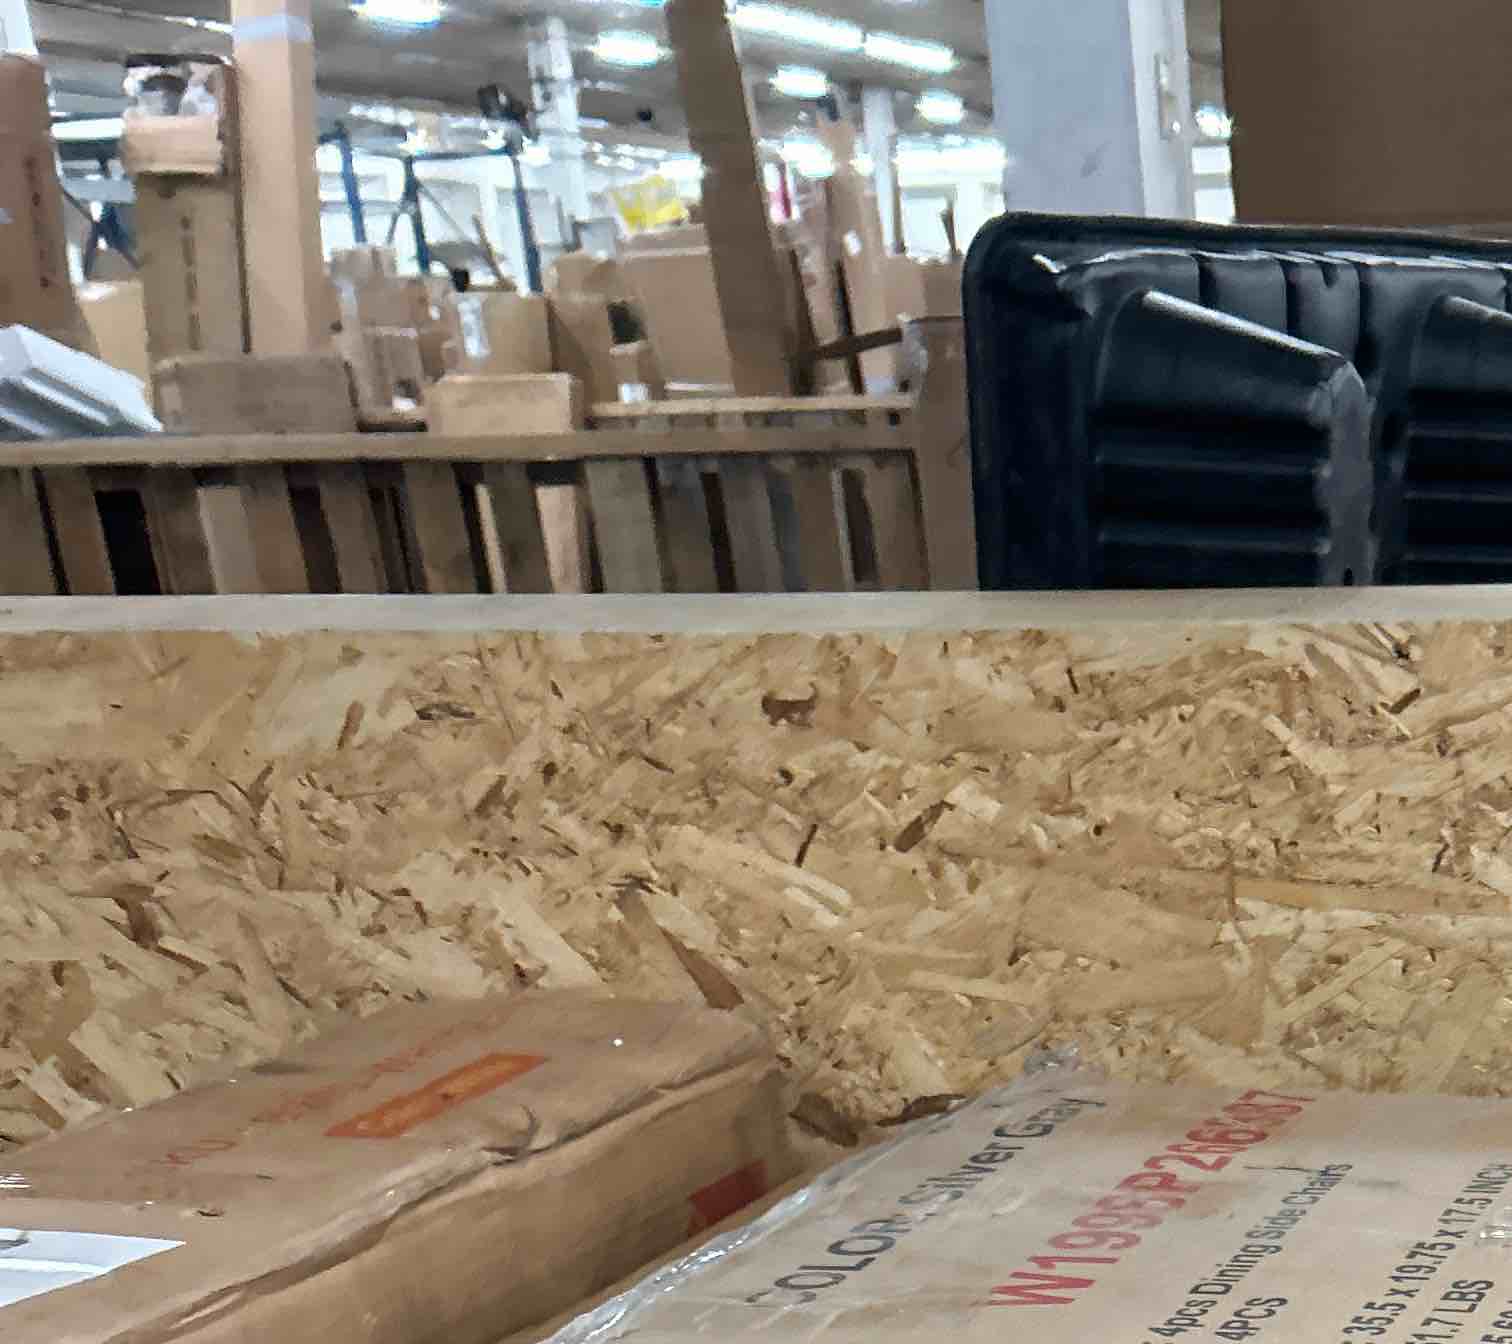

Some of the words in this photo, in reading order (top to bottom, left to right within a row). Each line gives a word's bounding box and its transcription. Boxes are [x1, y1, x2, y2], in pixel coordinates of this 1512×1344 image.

[993, 1099, 1108, 1138] Gray
[1437, 1198, 1494, 1223] 17.5
[1149, 1300, 1218, 1337] 4pcs
[1189, 1244, 1283, 1296] Dining
[1245, 1207, 1307, 1239] Side
[1282, 1164, 1353, 1205] Chairs
[1433, 1229, 1468, 1239] x
[1389, 1242, 1456, 1281] 19.75
[1385, 1288, 1419, 1298] x
[1432, 1279, 1494, 1313] LBS
[1214, 1297, 1288, 1341] 4PCS
[1342, 1302, 1407, 1336] 35.5
